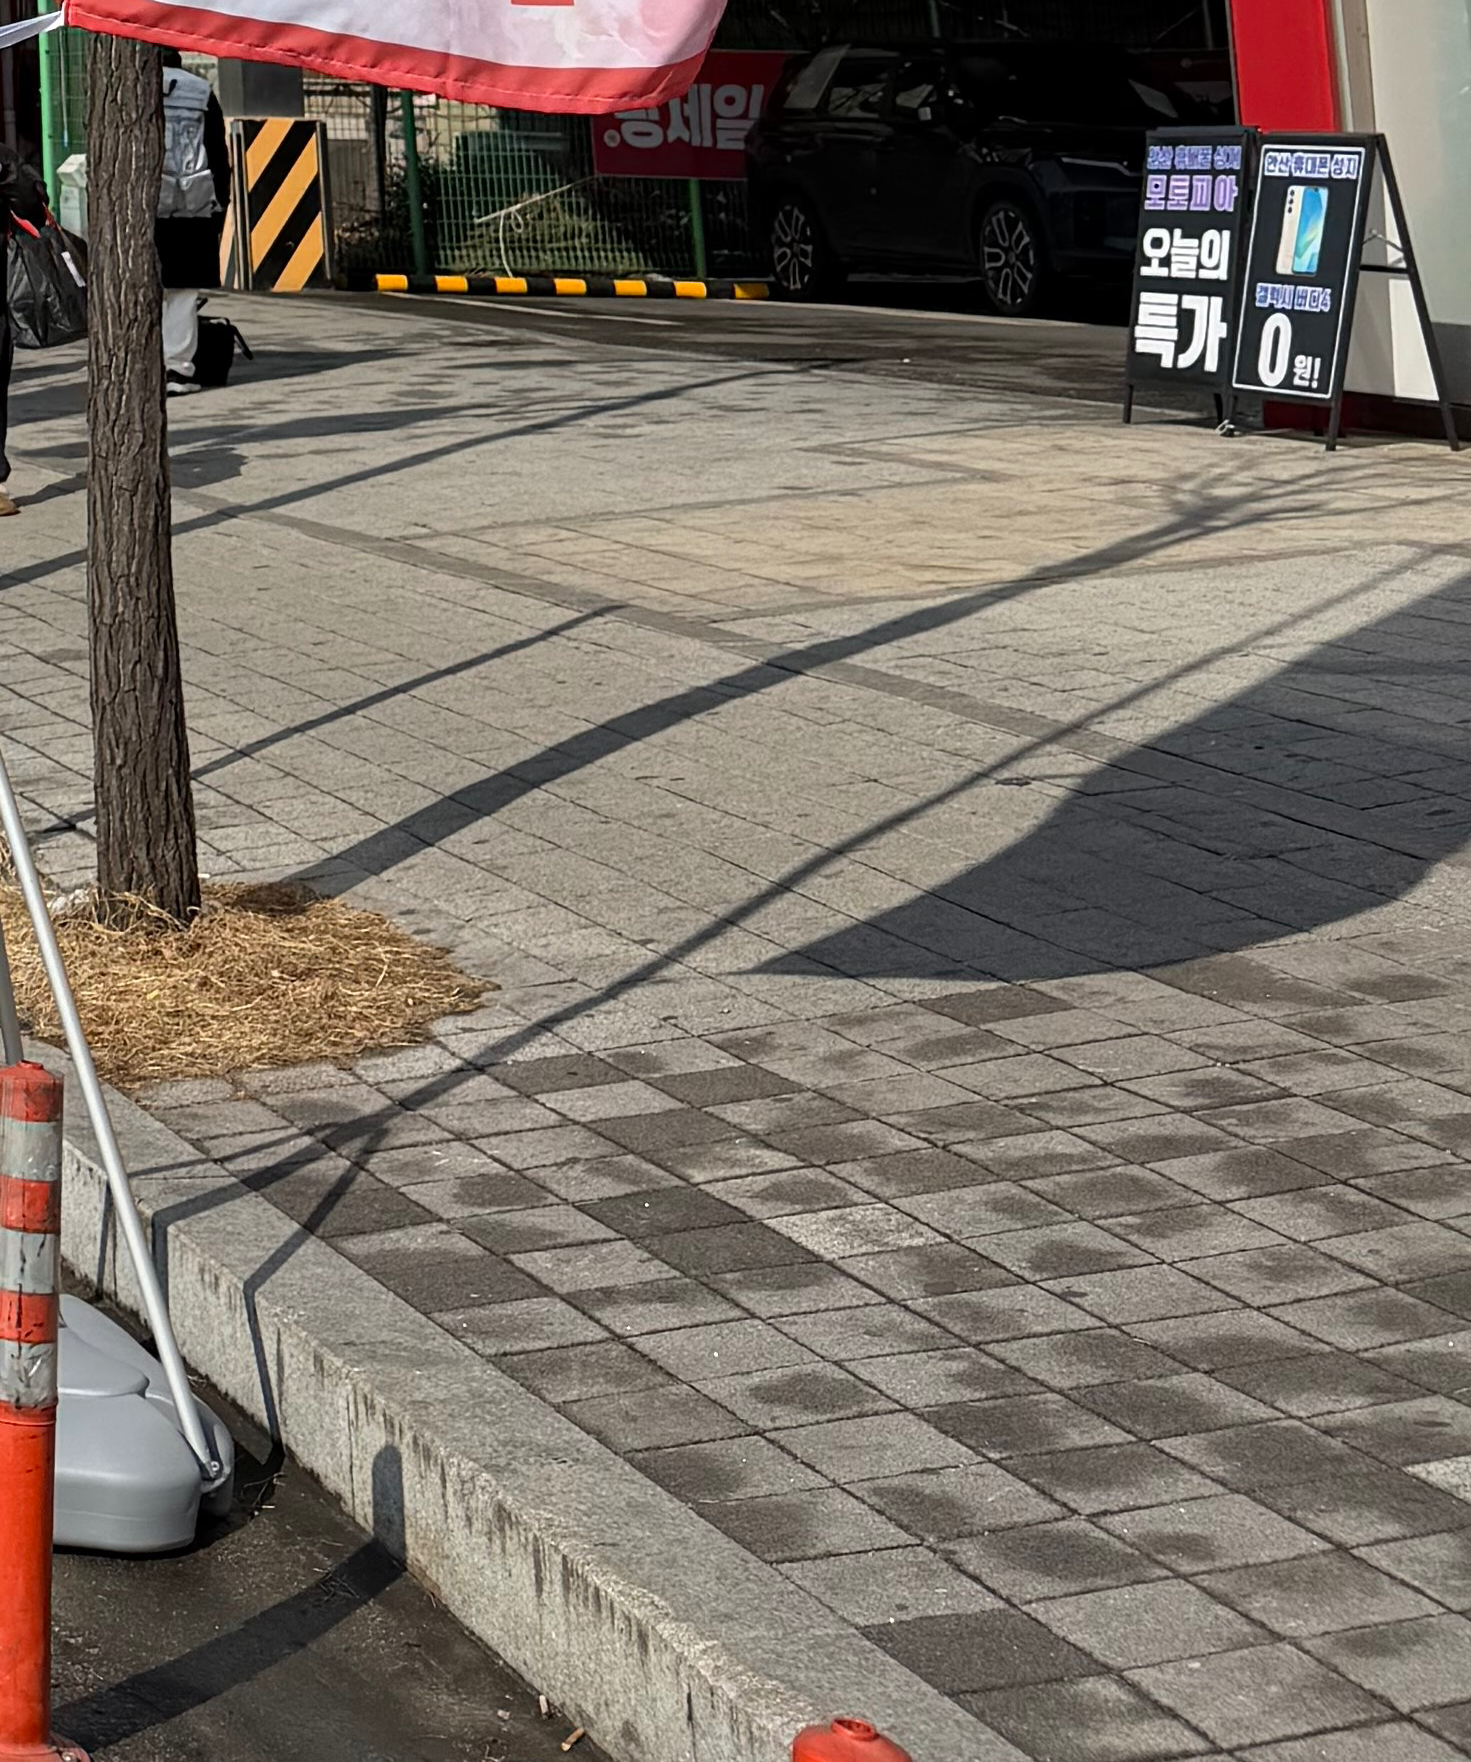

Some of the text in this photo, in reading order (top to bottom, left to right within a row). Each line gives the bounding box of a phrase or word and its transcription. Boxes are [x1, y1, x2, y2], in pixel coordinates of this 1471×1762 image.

[1146, 145, 1242, 170] 안산 휴대폰 성지
[1264, 151, 1360, 180] 안산 휴대폰 성지
[1144, 174, 1239, 212] 모토피아
[1139, 227, 1232, 281] 오늘의
[1255, 282, 1293, 310] 갤럭시
[1133, 290, 1228, 373] 특가
